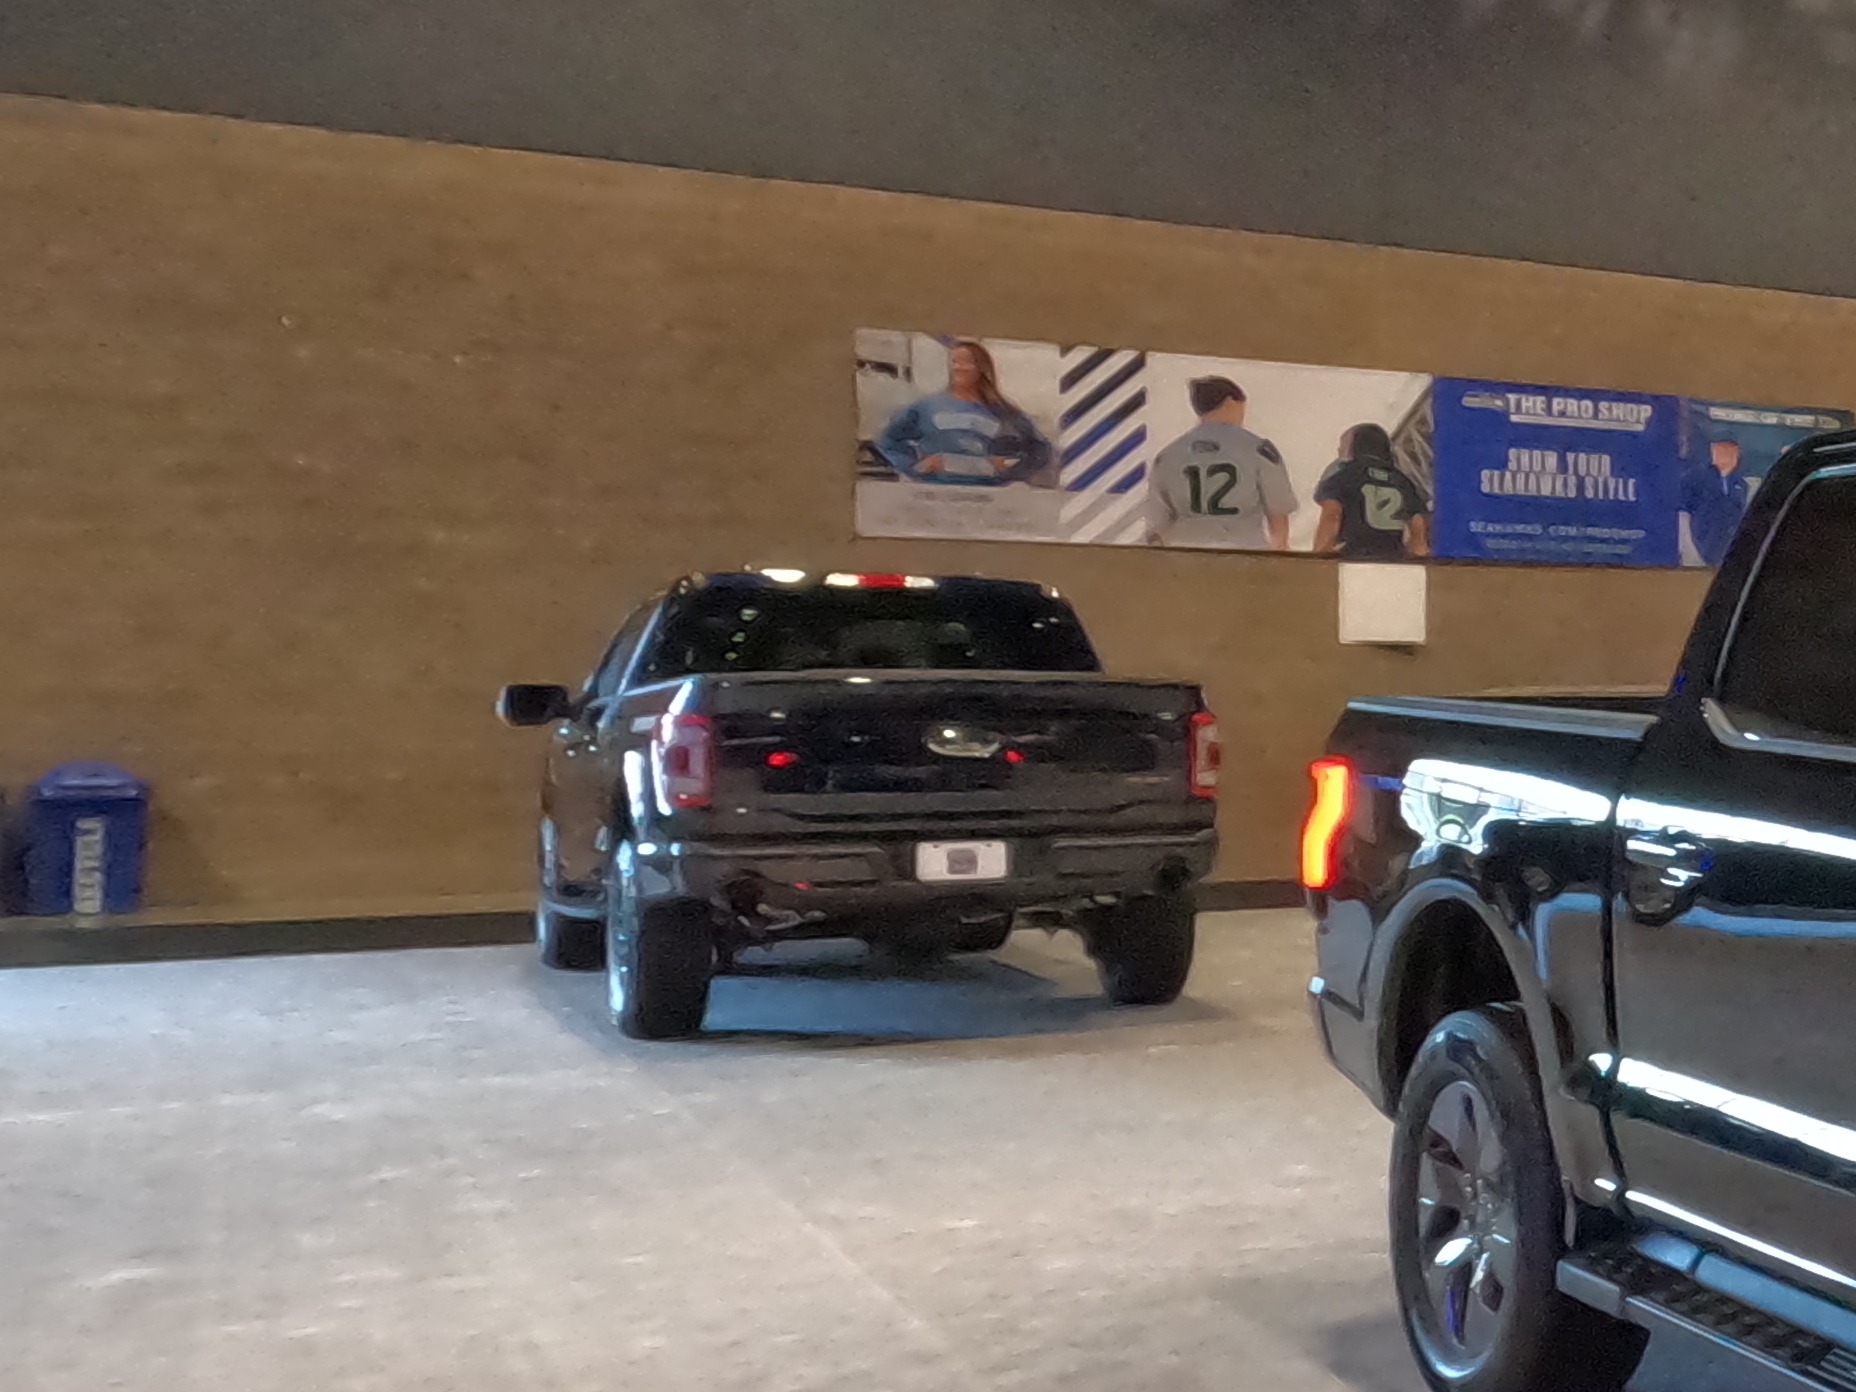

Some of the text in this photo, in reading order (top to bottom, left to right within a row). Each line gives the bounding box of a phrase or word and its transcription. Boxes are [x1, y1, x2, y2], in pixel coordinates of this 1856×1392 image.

[1505, 393, 1652, 424] THE PRO SHOP
[1508, 448, 1611, 477] SHOW YOUR
[1183, 463, 1239, 515] 12
[1480, 469, 1638, 501] SEAHAWKS STYLE
